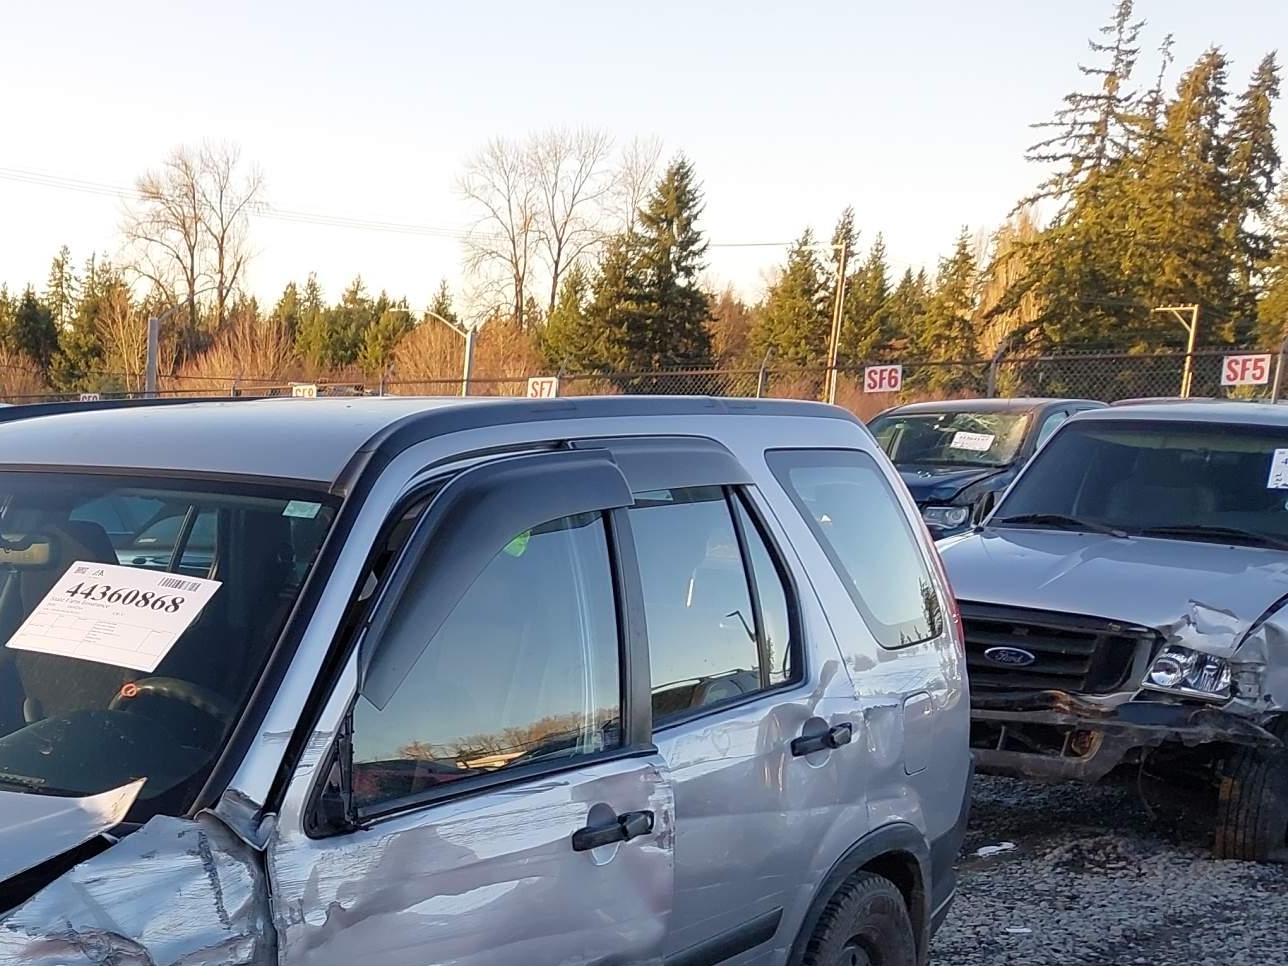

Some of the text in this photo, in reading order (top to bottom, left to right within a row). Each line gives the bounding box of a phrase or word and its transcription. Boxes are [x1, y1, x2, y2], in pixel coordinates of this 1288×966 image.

[866, 367, 899, 390] SF6
[1225, 357, 1266, 382] SF5
[530, 379, 554, 398] SF7
[65, 582, 185, 613] 44360868
